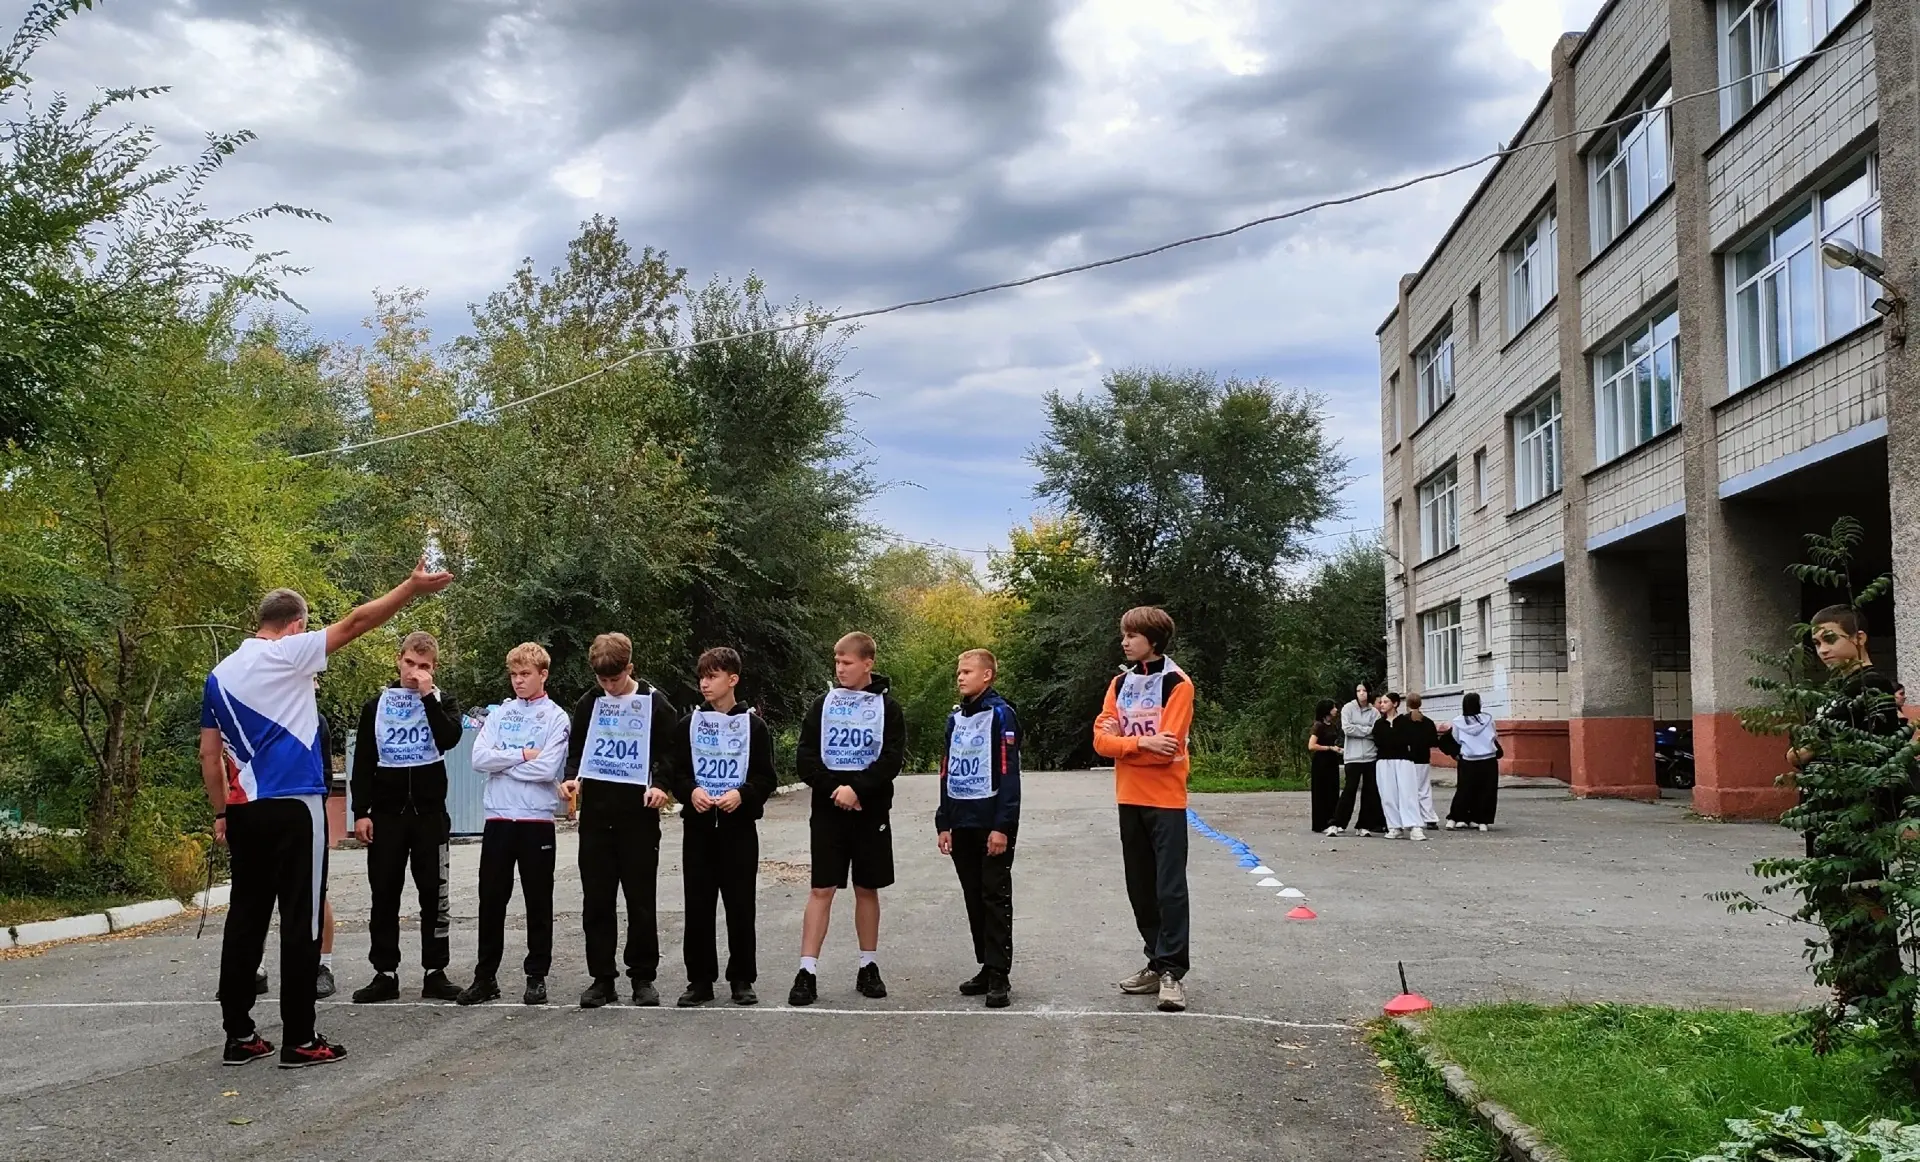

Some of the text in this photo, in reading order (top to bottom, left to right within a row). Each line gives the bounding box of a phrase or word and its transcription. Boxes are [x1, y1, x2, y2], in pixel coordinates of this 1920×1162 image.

[385, 726, 430, 744] 2203
[828, 727, 874, 747] 2206
[594, 738, 638, 760] 2204
[588, 759, 643, 769] НОВОСИБИРСКАЯ
[599, 767, 629, 776] ОБЛАСТЬ
[696, 757, 739, 778] 2202
